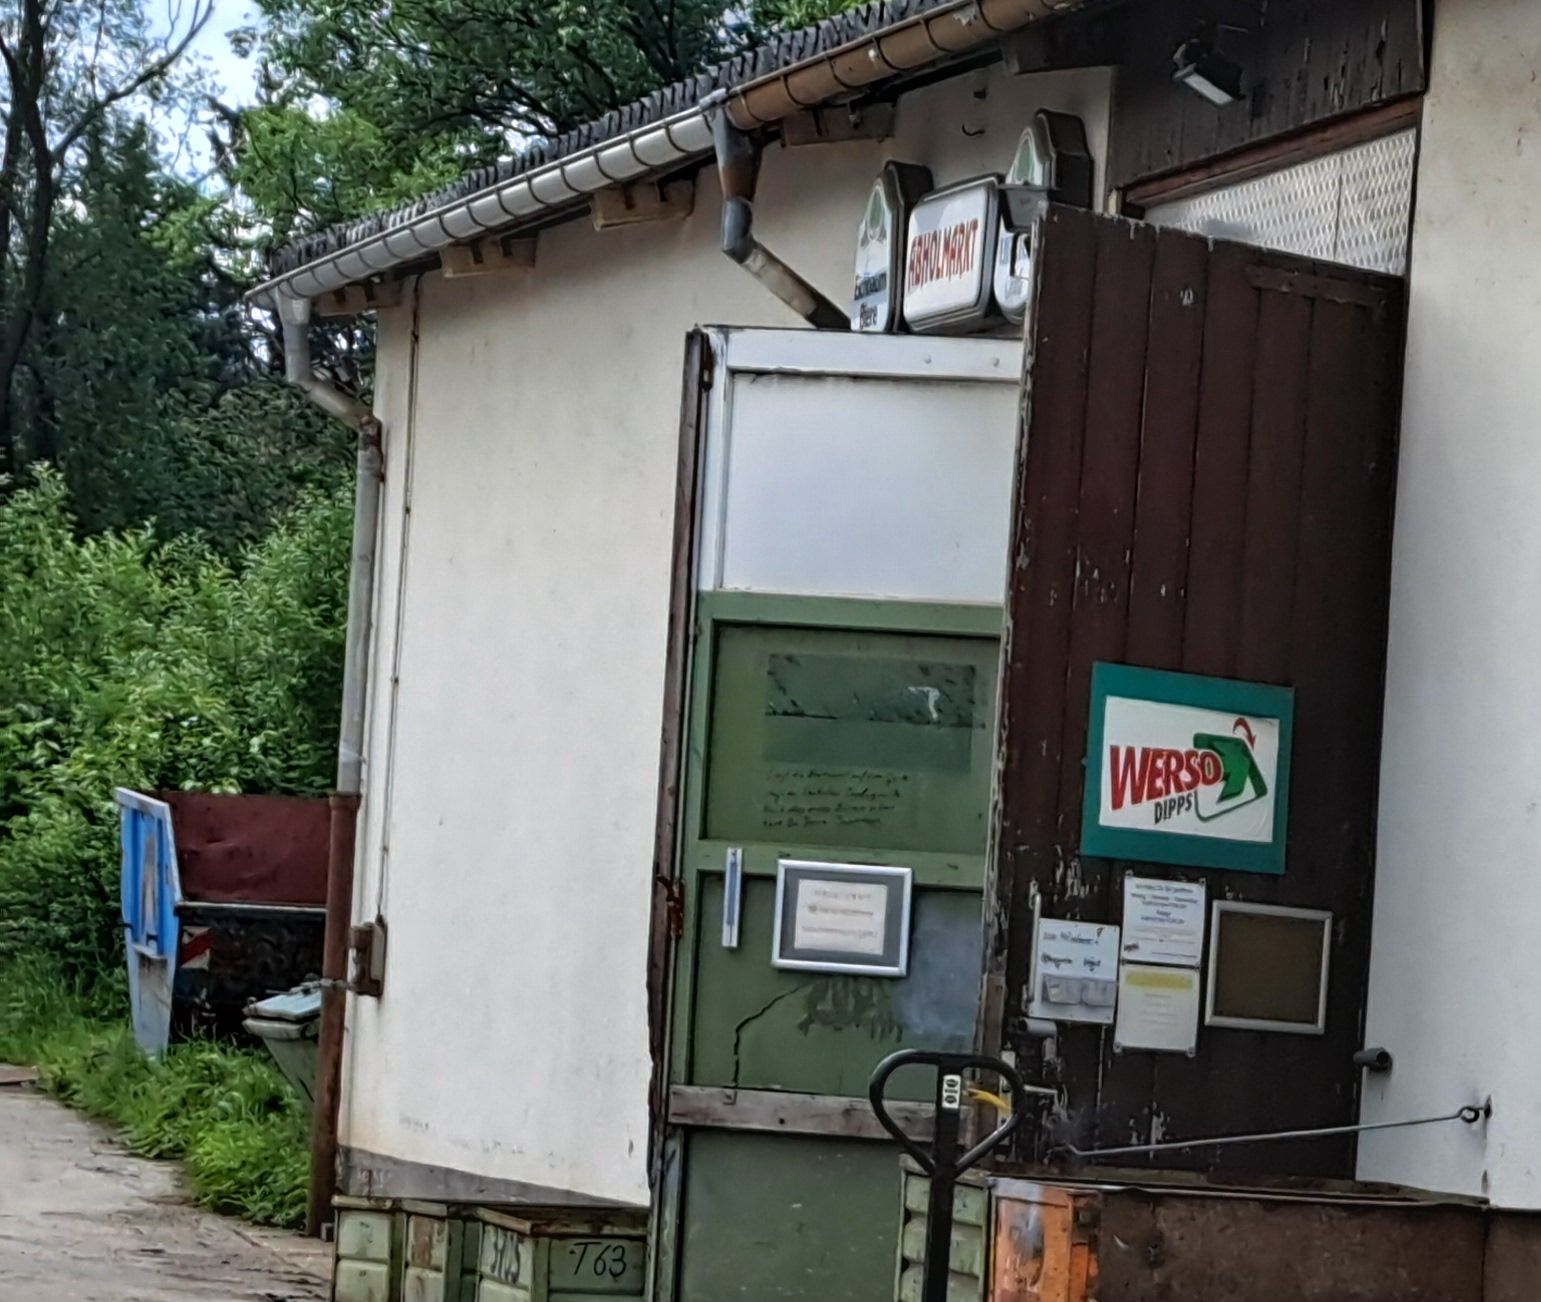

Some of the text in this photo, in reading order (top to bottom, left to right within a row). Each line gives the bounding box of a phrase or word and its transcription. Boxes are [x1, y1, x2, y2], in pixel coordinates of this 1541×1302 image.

[908, 218, 979, 293] ABHOLMARKT
[1110, 744, 1222, 811] WERSO
[1154, 795, 1193, 825] DIPPS
